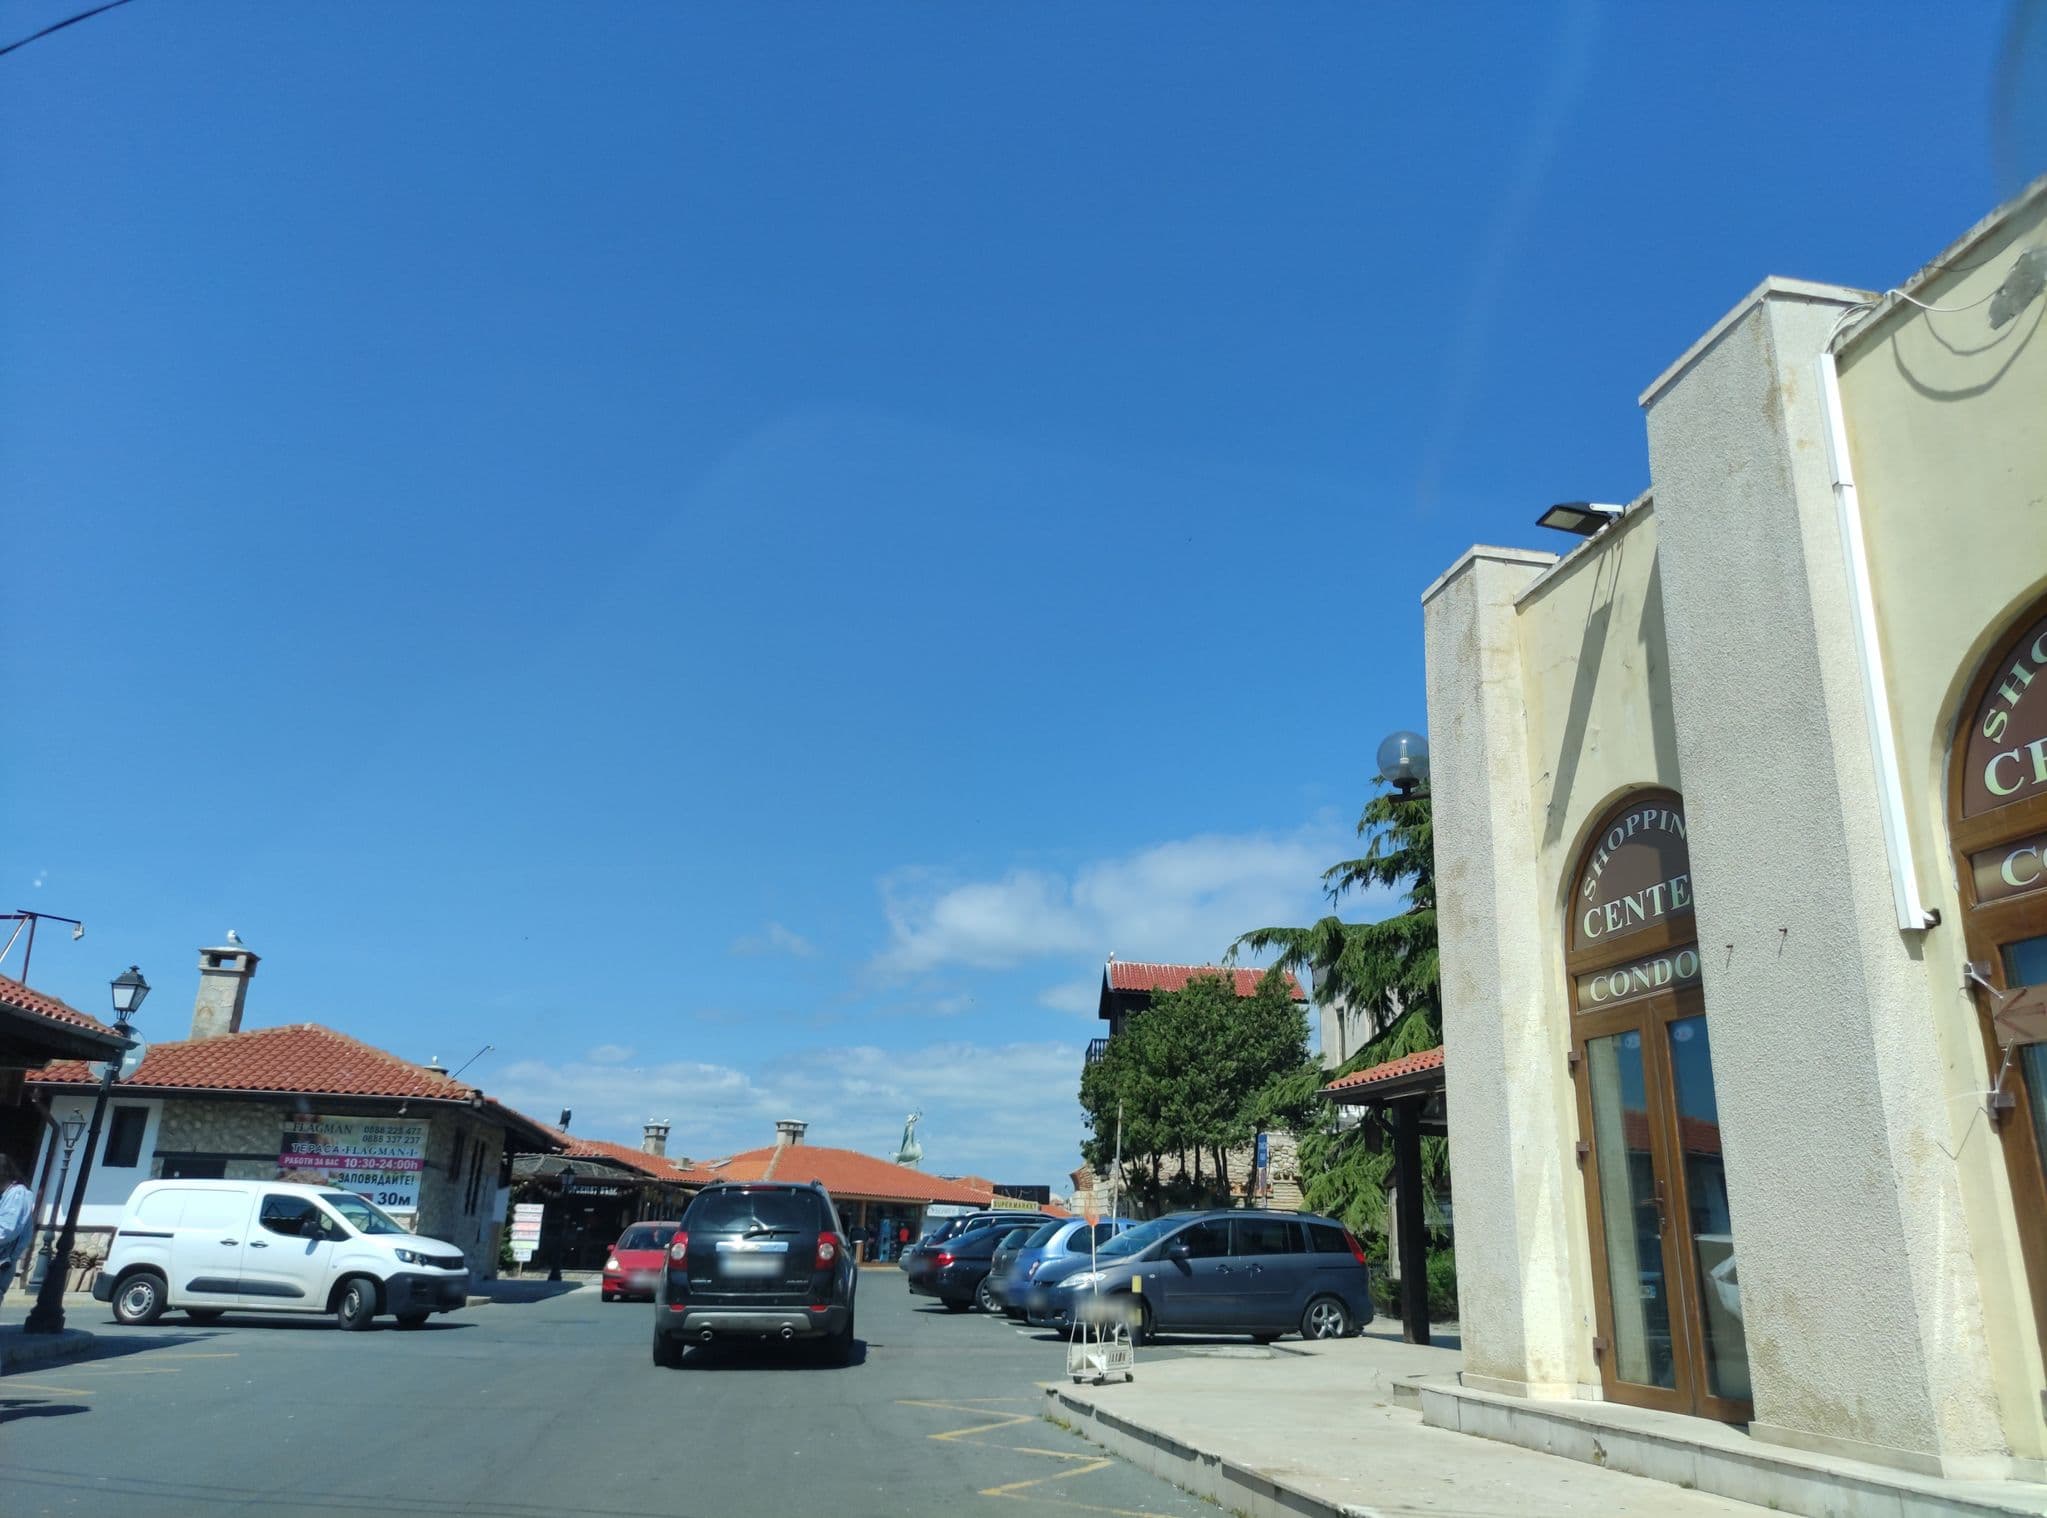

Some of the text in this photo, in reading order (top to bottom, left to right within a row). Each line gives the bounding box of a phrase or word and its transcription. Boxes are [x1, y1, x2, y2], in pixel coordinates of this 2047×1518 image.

[293, 1121, 353, 1134] FLAGMAN
[292, 1143, 339, 1154] ТЕРАСА
[284, 1156, 313, 1165] РАБОТИ
[314, 1157, 324, 1166] ЗА
[325, 1158, 340, 1167] ВАС
[993, 1200, 1037, 1210] SUPERMARKET
